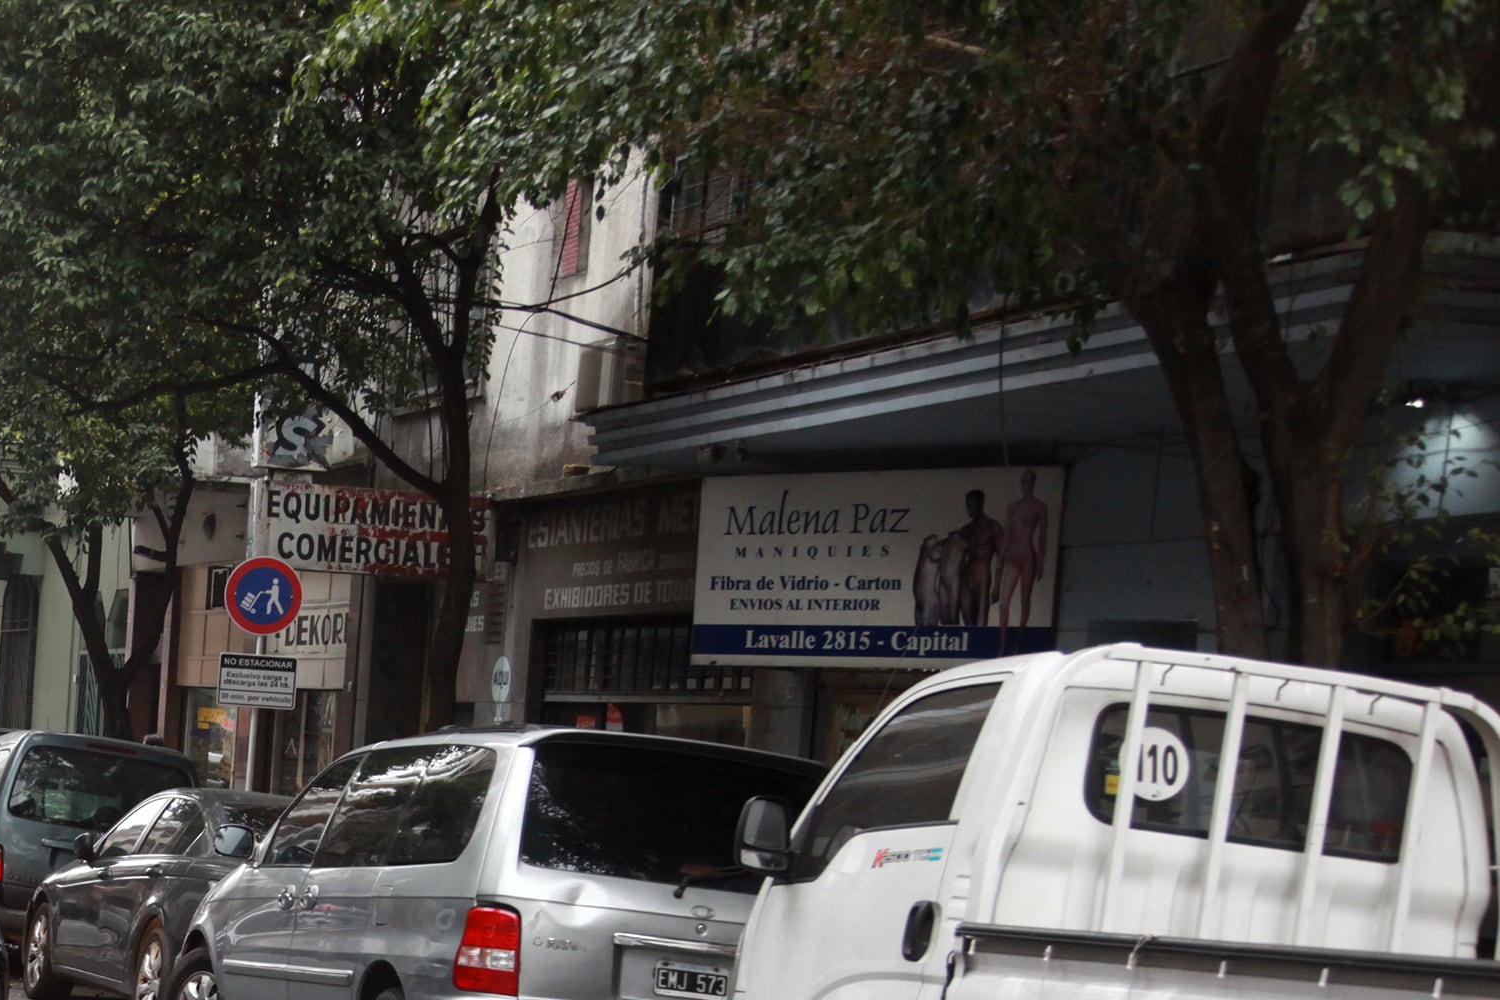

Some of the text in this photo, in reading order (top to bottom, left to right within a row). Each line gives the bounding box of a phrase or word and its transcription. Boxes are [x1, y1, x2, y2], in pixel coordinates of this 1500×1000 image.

[266, 489, 485, 534] EQUIPAMIENS
[724, 490, 911, 536] Malena Paz
[277, 531, 453, 569] COMERCIALE
[734, 544, 891, 560] MANIQUIES
[709, 576, 751, 591] Fibra
[756, 575, 775, 591] de
[780, 575, 829, 591] Vidrio
[844, 575, 902, 591] Carton
[544, 583, 630, 610] EXHIBIDORES
[633, 581, 653, 604] DE
[729, 598, 880, 612] ENVIOS AL INTERIOR
[745, 629, 816, 649] Lavalle
[822, 630, 871, 651] 2815
[890, 630, 969, 656] Capital
[224, 657, 293, 669] NO ESTACIONAR
[223, 679, 256, 687] descarga
[226, 671, 261, 680] Exclusivo
[262, 674, 282, 682] carga
[657, 968, 727, 996] EMJ 573
